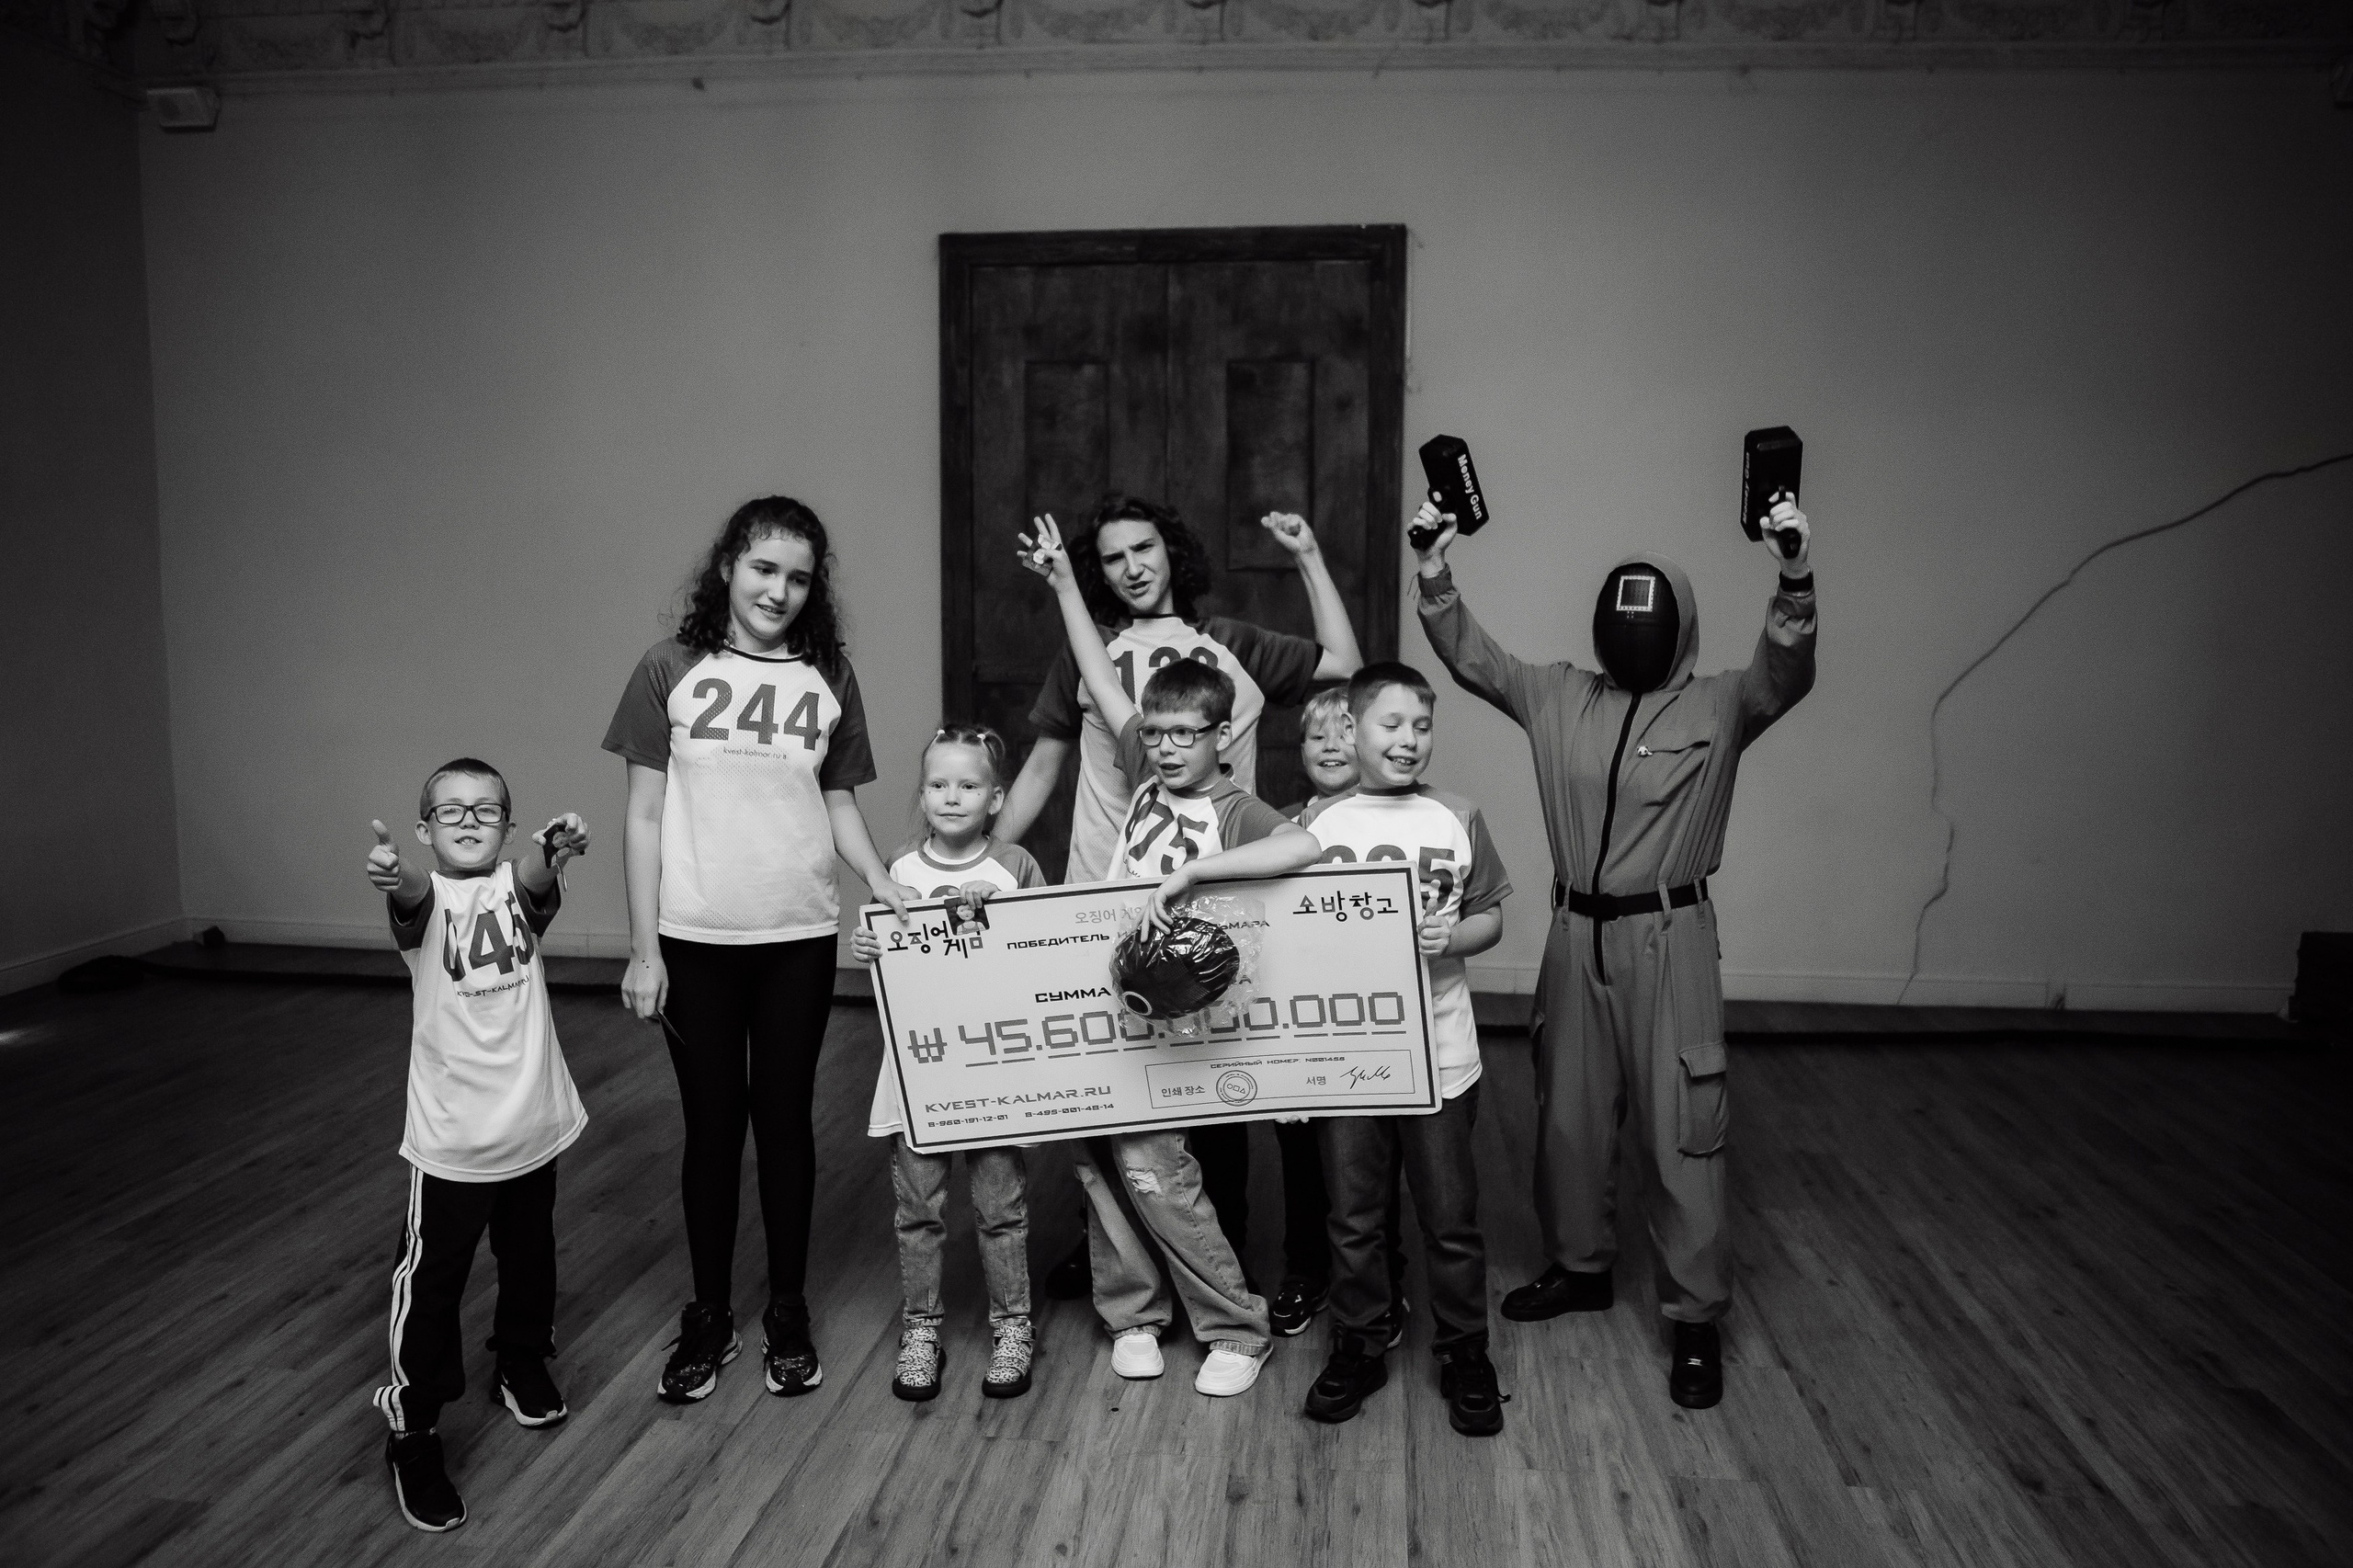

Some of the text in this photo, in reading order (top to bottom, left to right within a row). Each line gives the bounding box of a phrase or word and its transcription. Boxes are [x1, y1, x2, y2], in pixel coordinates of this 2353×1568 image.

[1458, 454, 1483, 520] Money Gun
[689, 677, 822, 751] 244
[1292, 890, 1398, 922] 소방창고
[1074, 908, 1117, 925] 오징어
[887, 920, 949, 954] 오징어
[1006, 933, 1109, 949] ПОБЕДИТЕЛЬ
[1035, 986, 1112, 1003] СУММА
[1210, 1059, 1263, 1069] СЕРИЙНЫЙ
[1306, 1075, 1327, 1085] 서명
[925, 1085, 1112, 1113] KVEST-KALMAR.RU
[1161, 1085, 1206, 1097] 인쇄 장소
